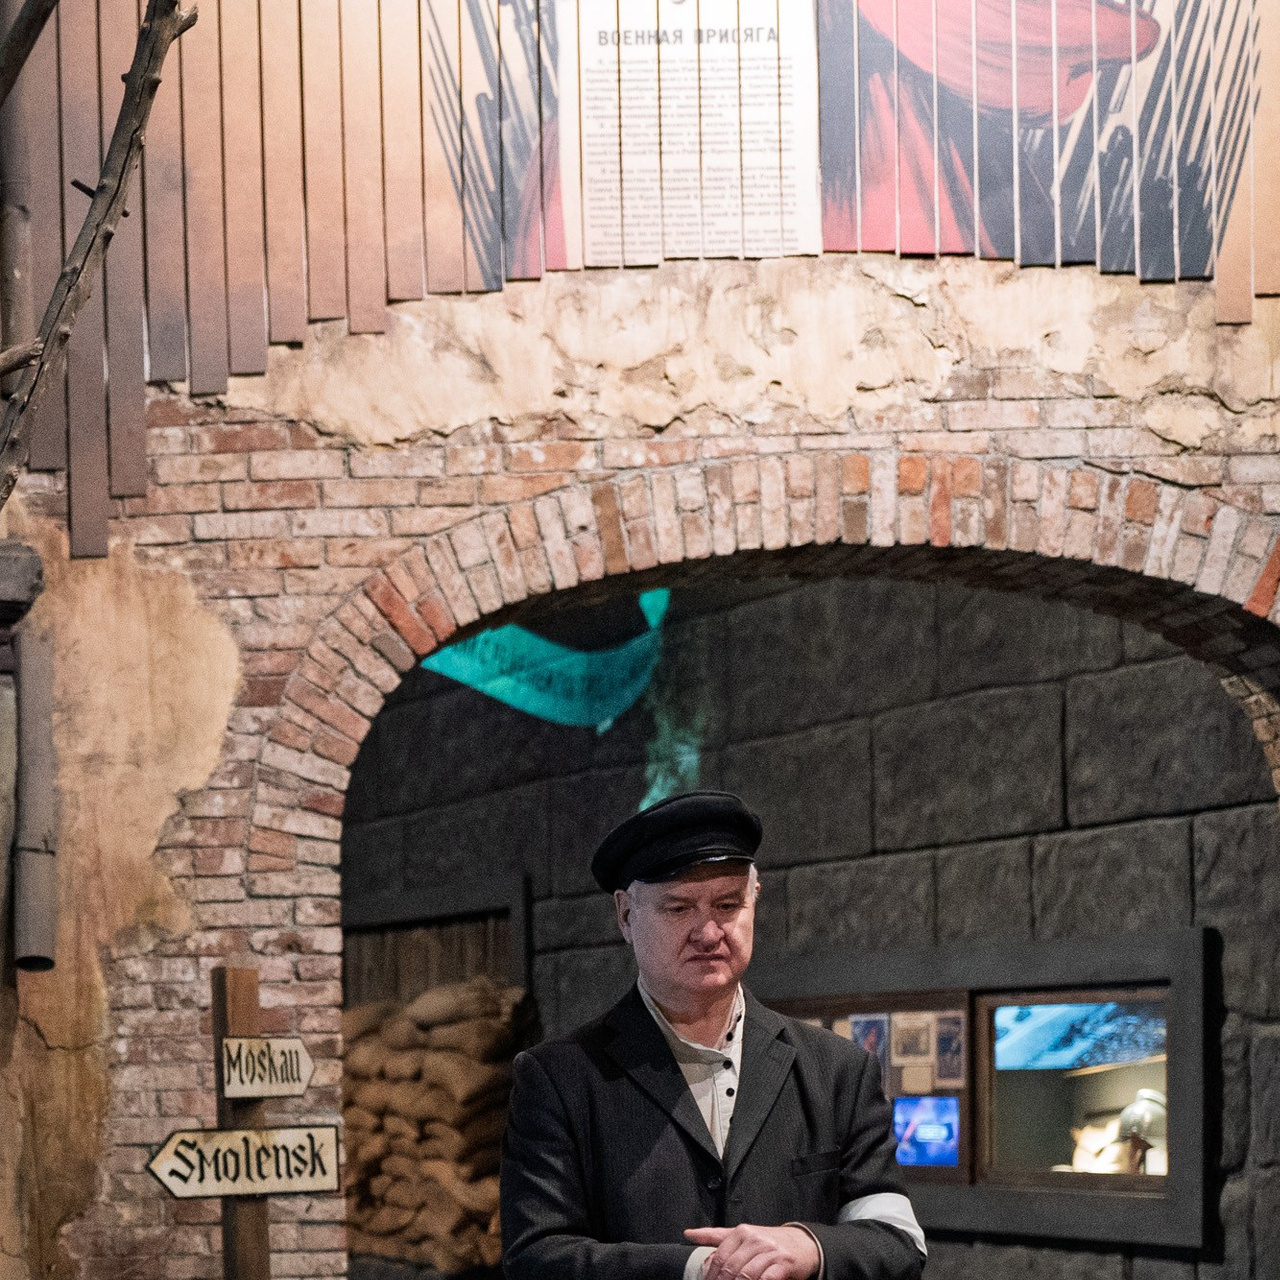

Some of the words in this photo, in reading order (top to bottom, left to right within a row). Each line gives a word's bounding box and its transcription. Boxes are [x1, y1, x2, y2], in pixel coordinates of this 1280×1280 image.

[597, 29, 684, 46] ВОЕННАЯ
[693, 27, 778, 45] ПРИСЯГА
[224, 1042, 302, 1085] Moskau
[168, 1132, 327, 1184] Smolensk
